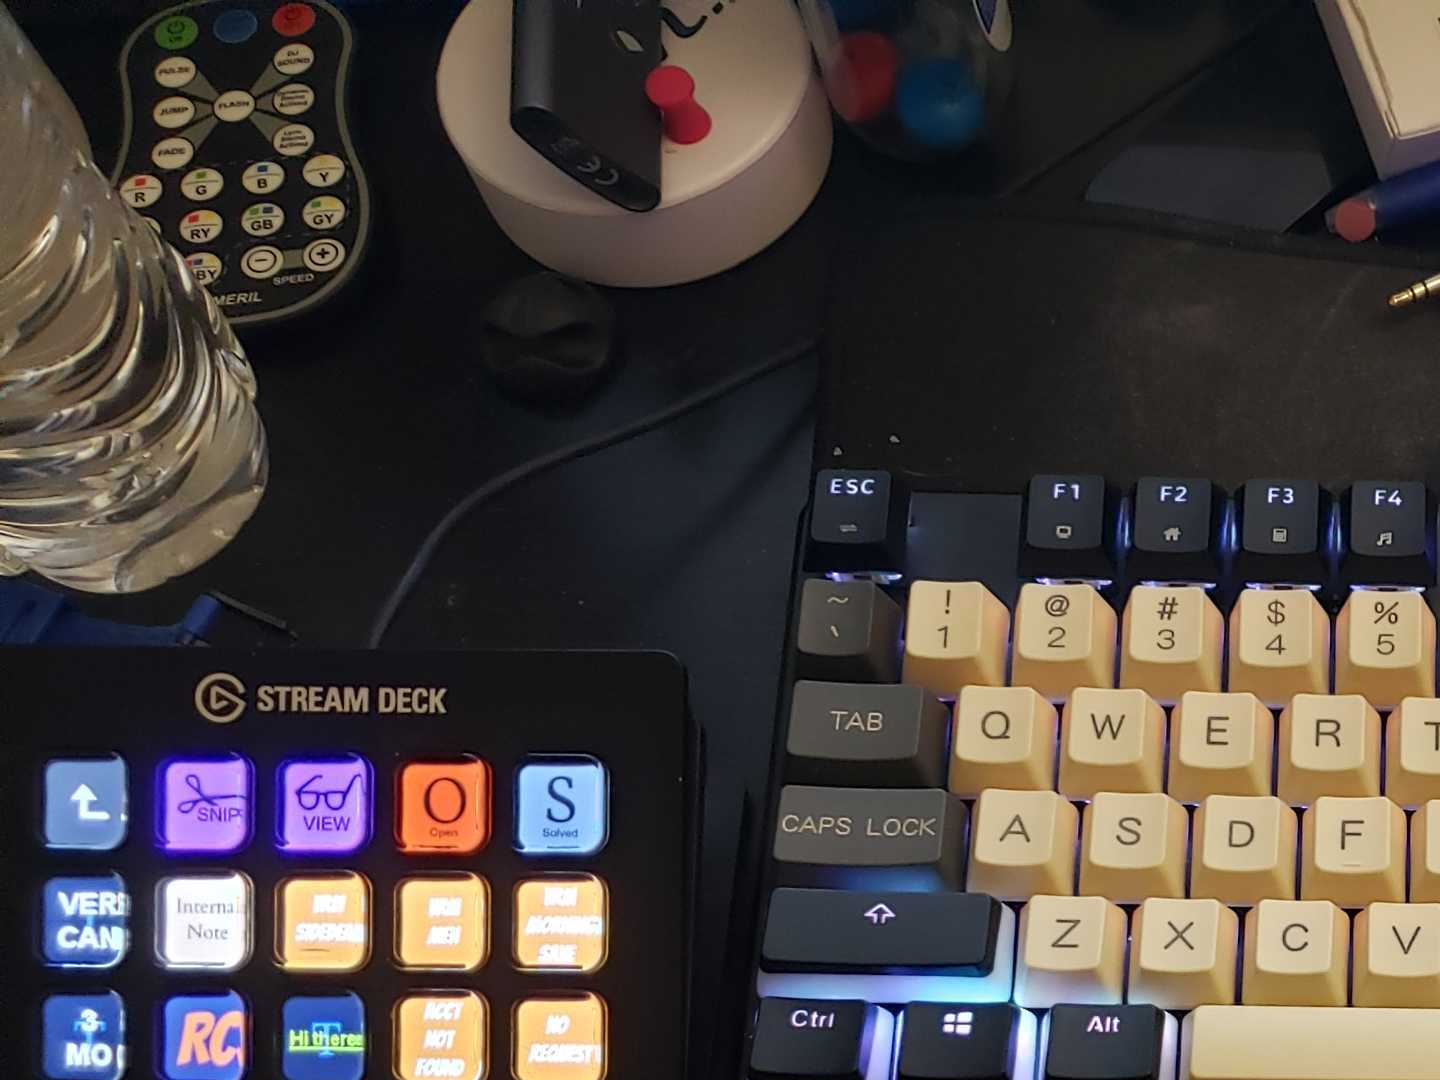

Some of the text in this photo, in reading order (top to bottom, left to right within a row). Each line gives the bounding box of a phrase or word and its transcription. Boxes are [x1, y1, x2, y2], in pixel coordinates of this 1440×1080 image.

[160, 106, 189, 116] JUMP
[158, 147, 187, 157] FADE
[196, 185, 207, 195] G
[257, 178, 267, 188] B
[135, 192, 145, 202] R
[251, 220, 274, 232] GB
[313, 213, 334, 226] GY
[190, 228, 211, 241] RY
[273, 274, 314, 287] SPEED
[830, 478, 875, 495] ESC
[1053, 483, 1080, 500] F1
[1160, 485, 1188, 502] F2
[1267, 487, 1294, 504] F3
[1374, 489, 1402, 506] F4
[1044, 594, 1070, 618] @
[1156, 596, 1179, 621] #
[1266, 599, 1286, 627] $
[1373, 601, 1399, 625] %
[937, 625, 949, 649] 1
[1047, 626, 1067, 649] 2
[1156, 628, 1176, 651] 3
[1264, 633, 1287, 656] 4
[1376, 633, 1396, 656] 5
[257, 685, 447, 714] STREAM DECK
[829, 710, 883, 732] TAB
[980, 710, 1011, 740] Q
[1090, 713, 1126, 741] W
[1206, 716, 1230, 746] E
[1315, 718, 1341, 748] R
[423, 776, 467, 825] O
[546, 775, 576, 824] S
[196, 806, 242, 824] SNIP
[303, 815, 351, 832] VIEW
[781, 814, 936, 837] CAPS LOCK
[429, 826, 459, 839] Open
[542, 827, 579, 838] Solved
[999, 814, 1031, 843] A
[1115, 816, 1142, 846] S
[1228, 820, 1255, 848] D
[1340, 819, 1365, 851] F
[187, 923, 229, 941] Note
[1050, 918, 1081, 949] Z
[1163, 920, 1195, 951] X
[1281, 923, 1309, 952] C
[1391, 925, 1422, 955] V
[544, 1014, 571, 1035] NO
[791, 1009, 835, 1028] Ctrl
[1086, 1015, 1121, 1033] Alt
[424, 1029, 457, 1049] NOT
[414, 1058, 466, 1077] FOUND
